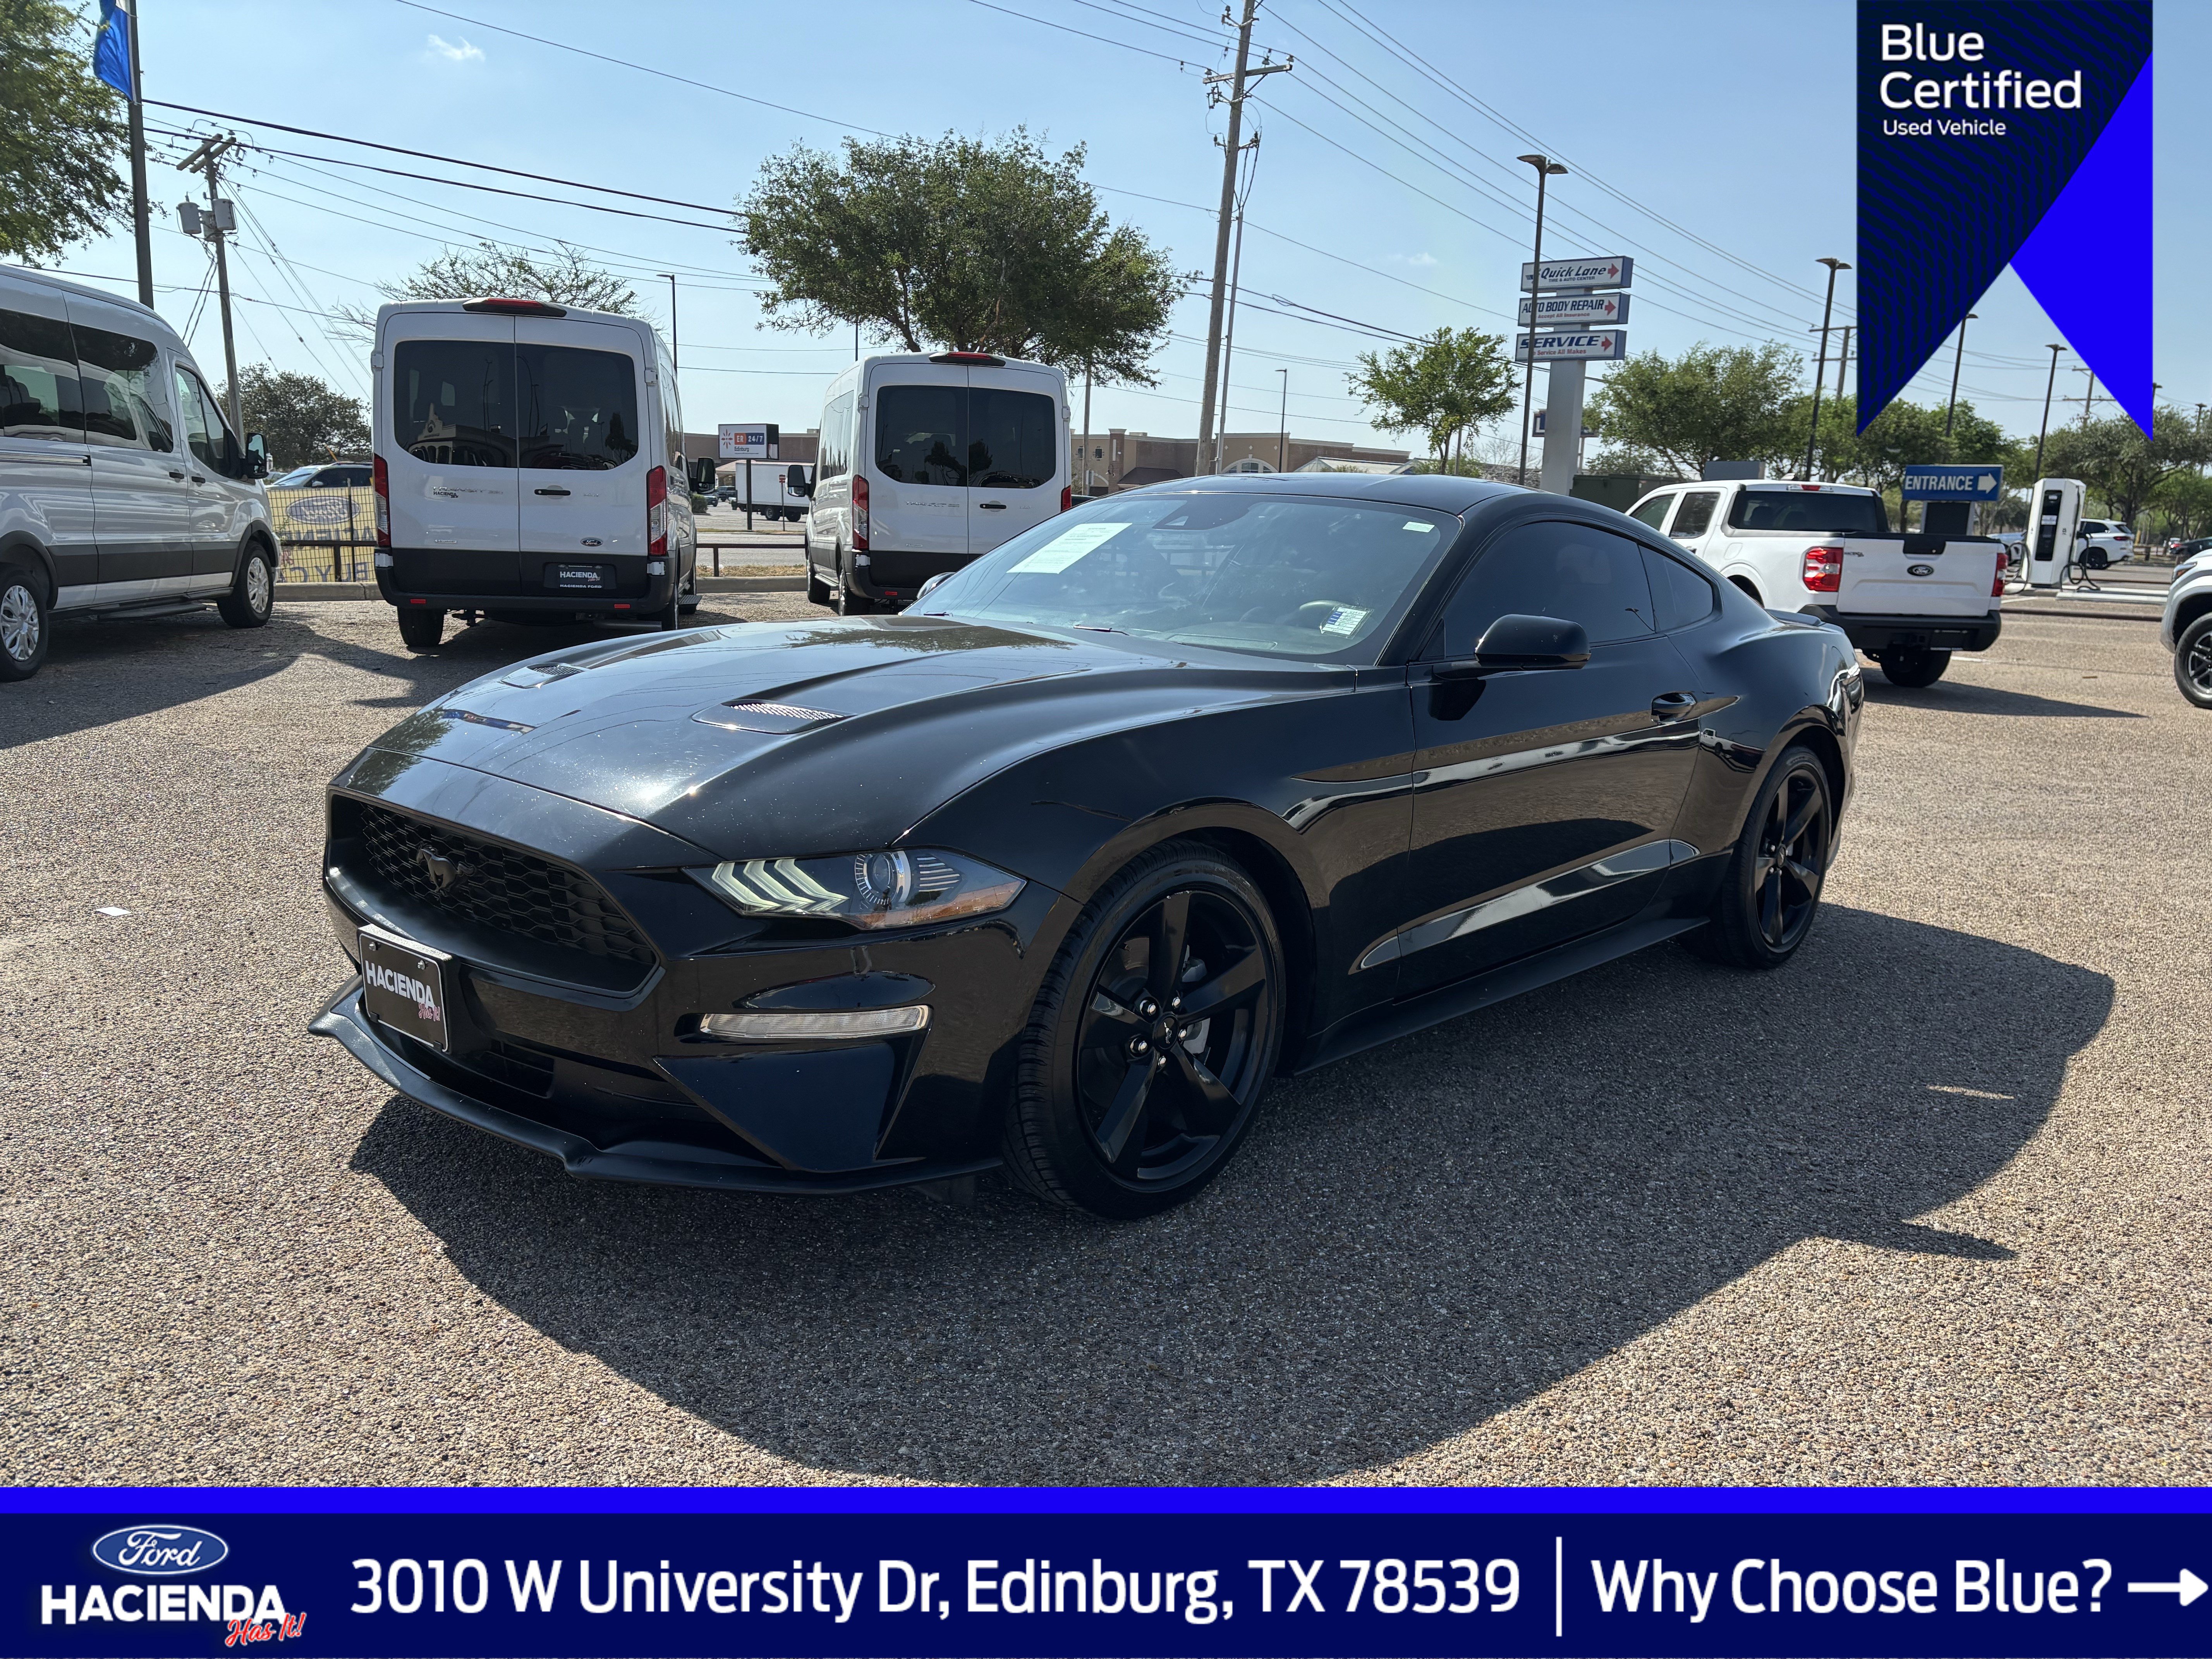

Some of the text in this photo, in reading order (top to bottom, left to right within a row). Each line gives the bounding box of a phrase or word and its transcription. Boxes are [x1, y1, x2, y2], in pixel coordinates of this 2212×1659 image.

[1541, 266, 1606, 280] Quick Lane
[1522, 299, 1604, 313] AUO BODY REPAIR
[1519, 336, 1601, 349] SERVICE
[1905, 475, 1974, 491] ENTRANCE
[365, 960, 435, 1012] HACIENDA
